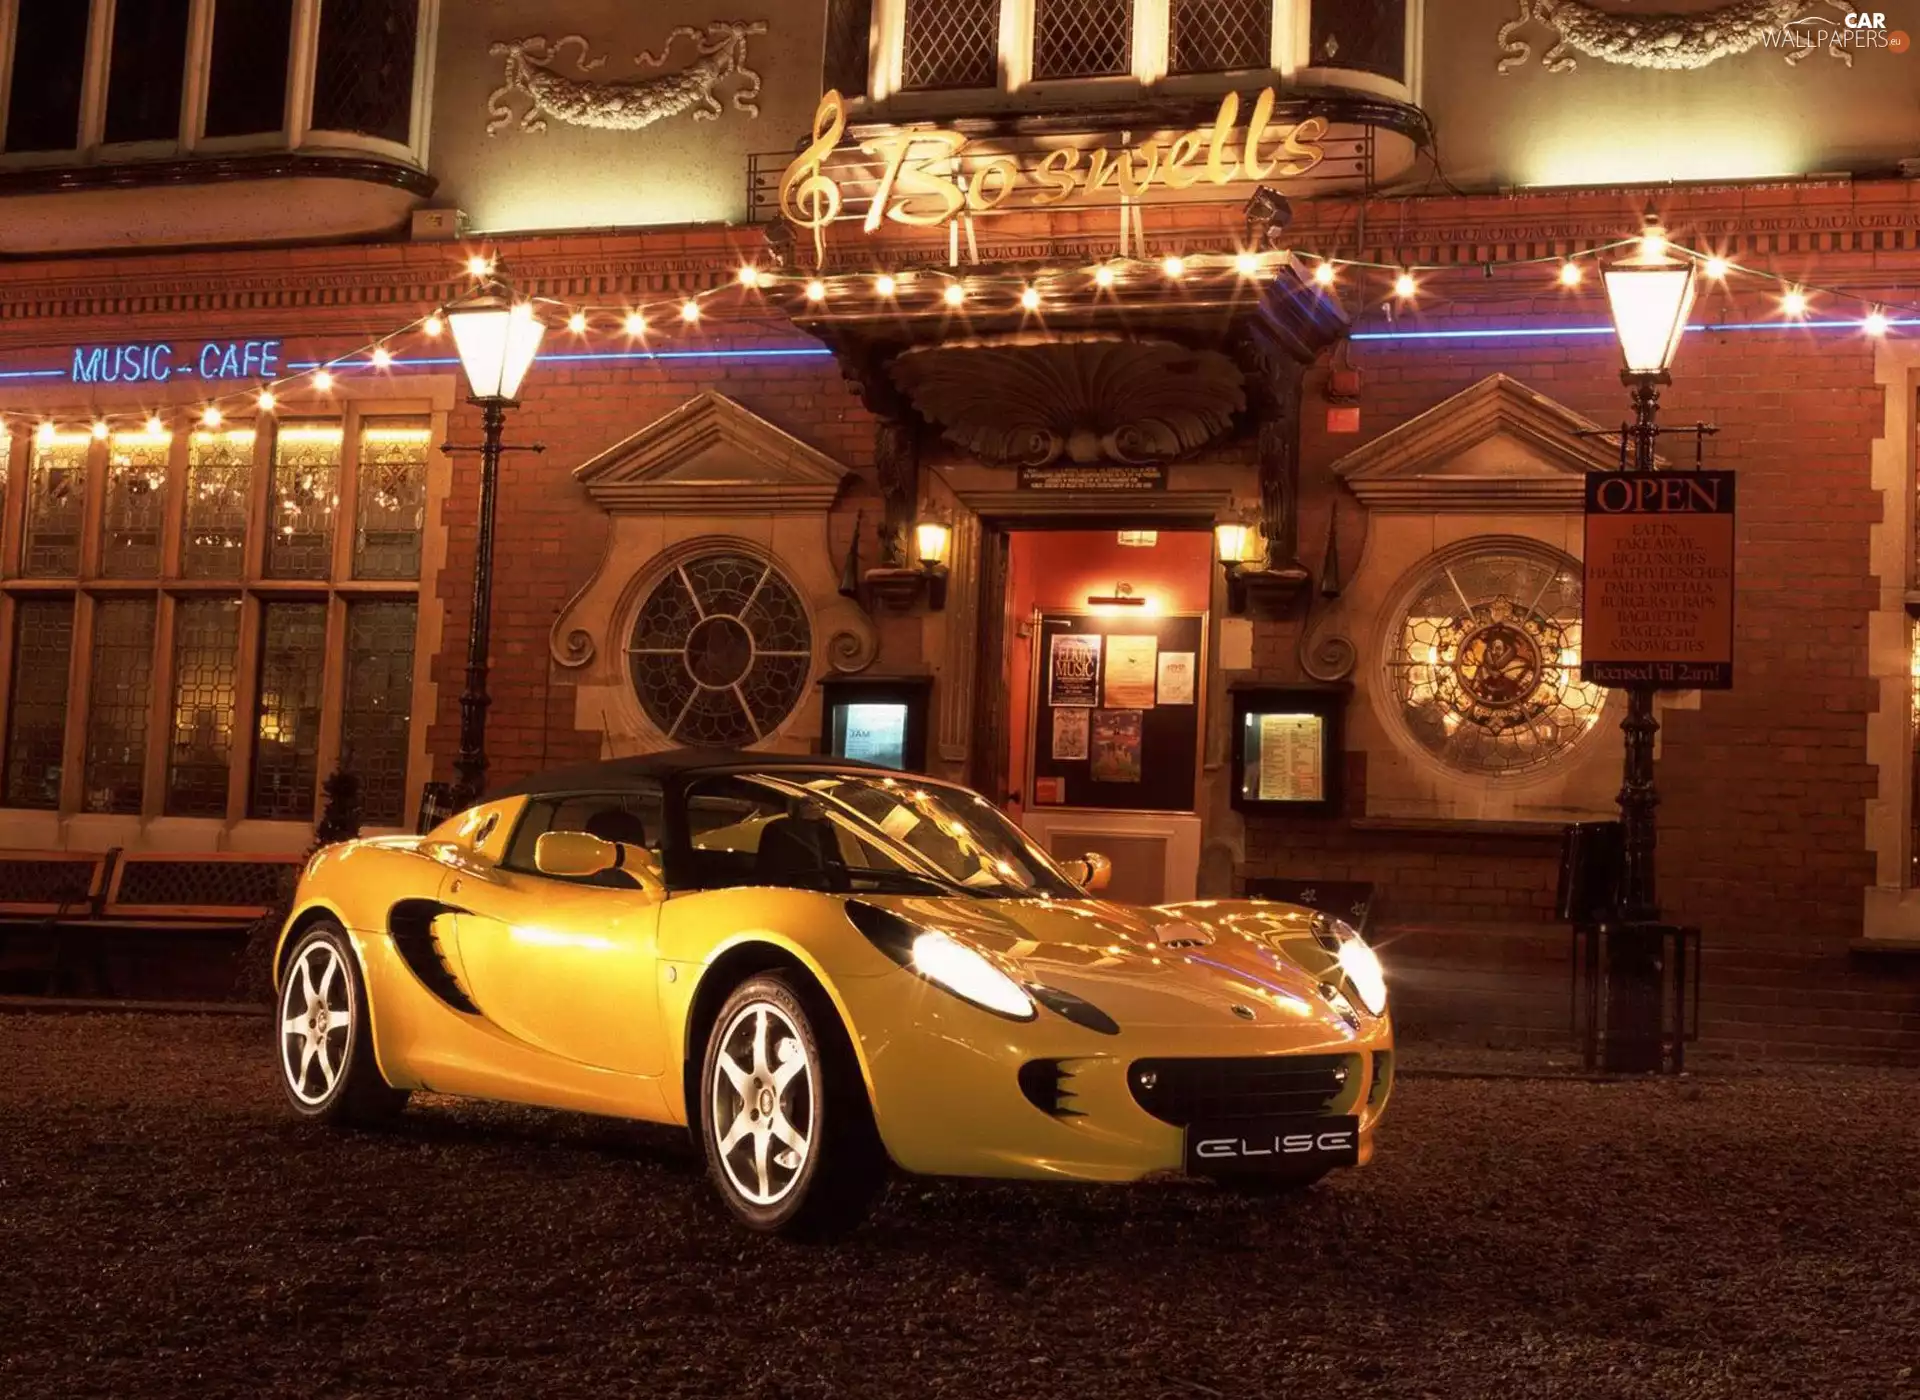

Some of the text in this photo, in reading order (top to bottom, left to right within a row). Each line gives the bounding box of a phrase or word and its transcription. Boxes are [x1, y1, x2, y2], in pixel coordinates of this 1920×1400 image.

[859, 85, 1330, 235] Boswells
[72, 344, 171, 383] MUSIC
[200, 341, 281, 379] CAFE
[1597, 478, 1721, 513] OPEN
[1632, 524, 1678, 536] EAT IN
[1614, 538, 1649, 550] TAKE
[1589, 567, 1729, 579] HEALTHY LUNCHES
[1604, 581, 1713, 593] DAILY SPECIALS
[1196, 1131, 1352, 1158] ELISE
